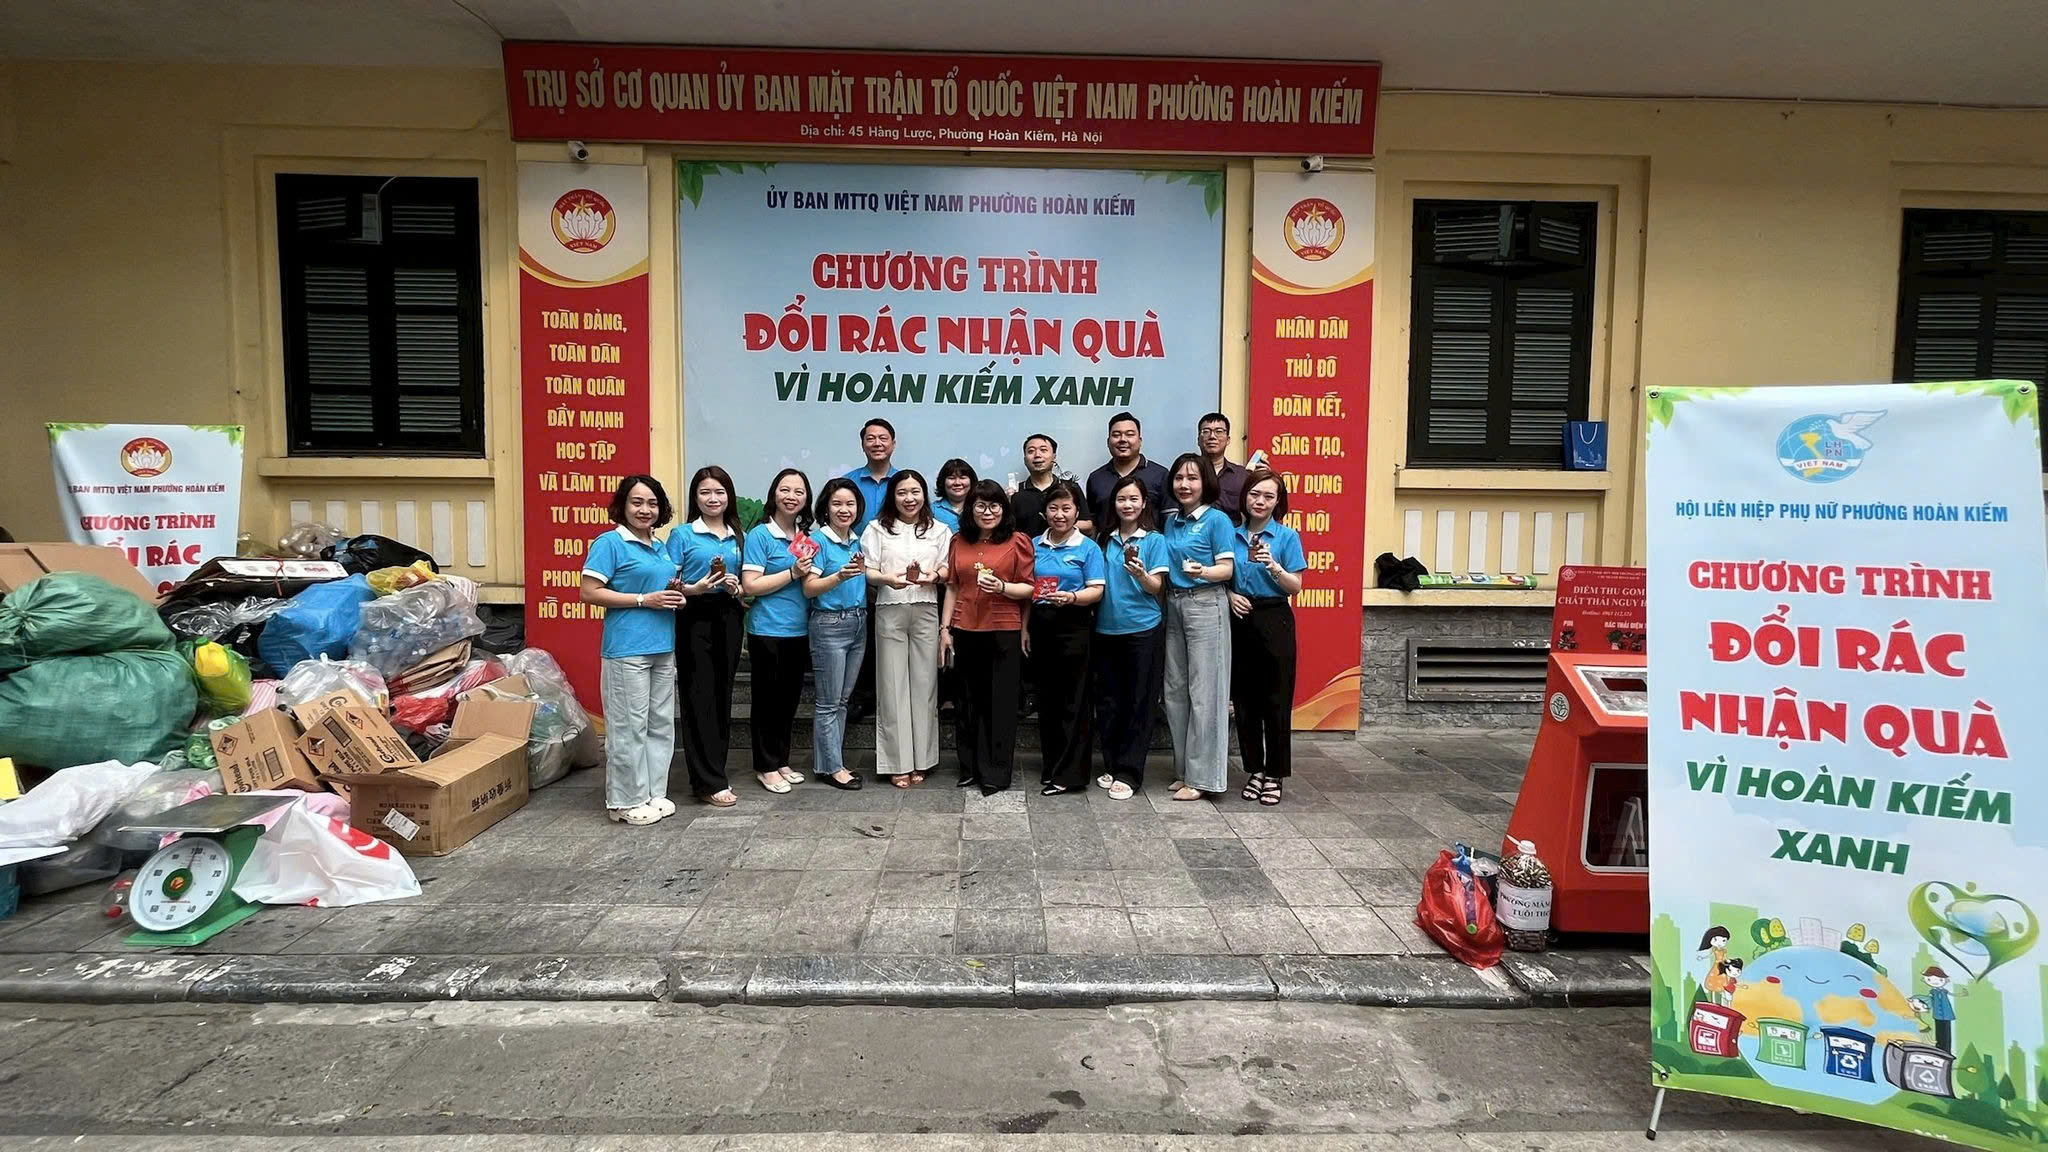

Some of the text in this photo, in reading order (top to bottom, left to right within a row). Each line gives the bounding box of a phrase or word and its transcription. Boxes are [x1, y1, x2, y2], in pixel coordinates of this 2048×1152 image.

[523, 58, 1363, 125] TRỤ SỞ CƠ QUAN ỦY BAN MẶT TRẬN TỔ QUỐC VIỆT NAM PHƯỜNG HOÀN KIẾM
[800, 124, 819, 138] Địa
[849, 126, 864, 137] 45
[868, 125, 899, 140] Hàng
[904, 127, 936, 141] Lược,
[939, 128, 983, 143] Phường
[988, 129, 1019, 142] Hoàn
[1024, 129, 1057, 143] Kiếm,
[1061, 131, 1078, 143] Hà
[1083, 131, 1102, 145] Nội
[767, 185, 1135, 217] ỦY BAN MTTQ VIỆT NAM PHƯỜNG HOÀN KIẾM
[811, 250, 1098, 296] CHƯƠNG TRÌNH
[542, 308, 627, 333] TOÀN ĐẢNG,
[742, 294, 1165, 365] ĐỔI RÁC NHẬN QUÀ
[1275, 316, 1348, 340] NHÂN DÂN
[549, 341, 620, 364] TOÀN DÂN
[1285, 353, 1338, 378] THỦ ĐÔ
[545, 374, 625, 397] TOÀN QUÂN
[773, 360, 1134, 406] VÌ HOÀN KIẾM XANH
[547, 402, 624, 431] ĐẨY MẠNH
[1273, 391, 1346, 420] ĐOÀN KẾT,
[556, 440, 617, 463] HỌC TẬP
[1271, 433, 1345, 459] SÁNG TẠO,
[1822, 460, 1843, 468] NAM
[134, 485, 150, 493] NAM
[538, 471, 625, 493] VÀ LÀM THE
[1280, 471, 1343, 498] ÂY DỰNG
[81, 511, 216, 531] HƯƠNG TRÌNH
[550, 506, 570, 523] TƯ
[1306, 509, 1330, 535] NỘI
[1676, 499, 2009, 524] HỘI LIÊN HIỆP PHỤ NỮ PHƯỜNG HOÀN KIẾM
[146, 540, 202, 567] RÁC
[554, 538, 583, 558] ĐẠO
[1307, 551, 1339, 573] ĐẸP,
[542, 570, 581, 588] PHON
[1600, 586, 1620, 595] THU
[1622, 588, 1645, 596] GOM
[1688, 559, 1993, 601] CHƯƠNG TRÌNH
[1296, 588, 1335, 608] MINH
[1612, 599, 1640, 607] NGUY
[1708, 603, 1967, 679] ĐỔI RÁC
[1679, 686, 2009, 758] NHẬN QUÀ
[1686, 754, 2012, 825] VÌ HOÀN KIẾM
[1771, 828, 1911, 875] XANH
